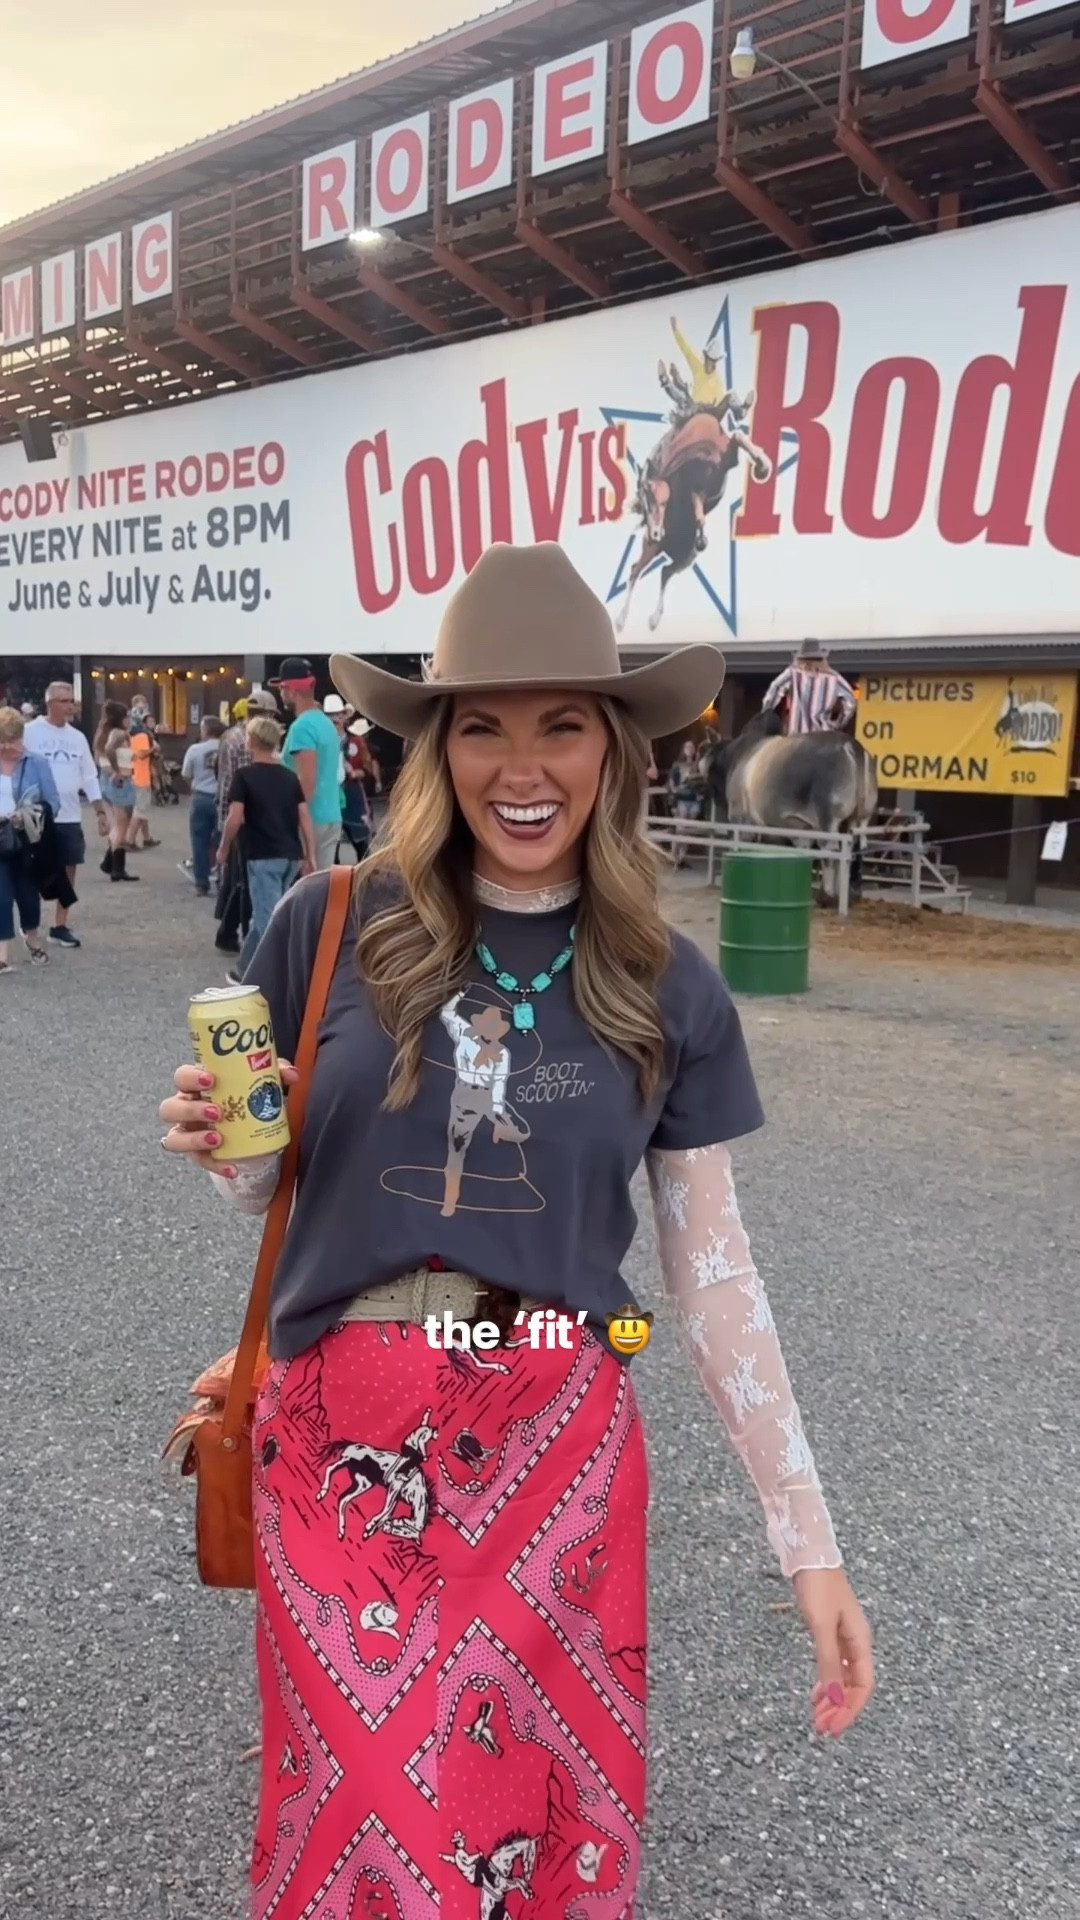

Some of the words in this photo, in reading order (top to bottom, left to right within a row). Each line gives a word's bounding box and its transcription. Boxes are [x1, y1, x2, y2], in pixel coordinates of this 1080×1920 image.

[309, 20, 704, 240] RODEO
[0, 477, 70, 522] CODY
[78, 464, 146, 510] NITE
[155, 441, 285, 499] RODEO
[0, 524, 84, 567] EVERY
[93, 515, 163, 558] NITE
[171, 519, 198, 551] at
[206, 499, 290, 548] 8PM
[8, 578, 72, 612] June
[78, 580, 92, 608] &
[98, 566, 160, 614] July
[169, 568, 185, 604] &
[192, 564, 272, 612] Aug.
[866, 677, 974, 702] Pictures
[863, 721, 894, 740] on
[1010, 770, 1037, 784] $10
[534, 1062, 584, 1083] BOOT
